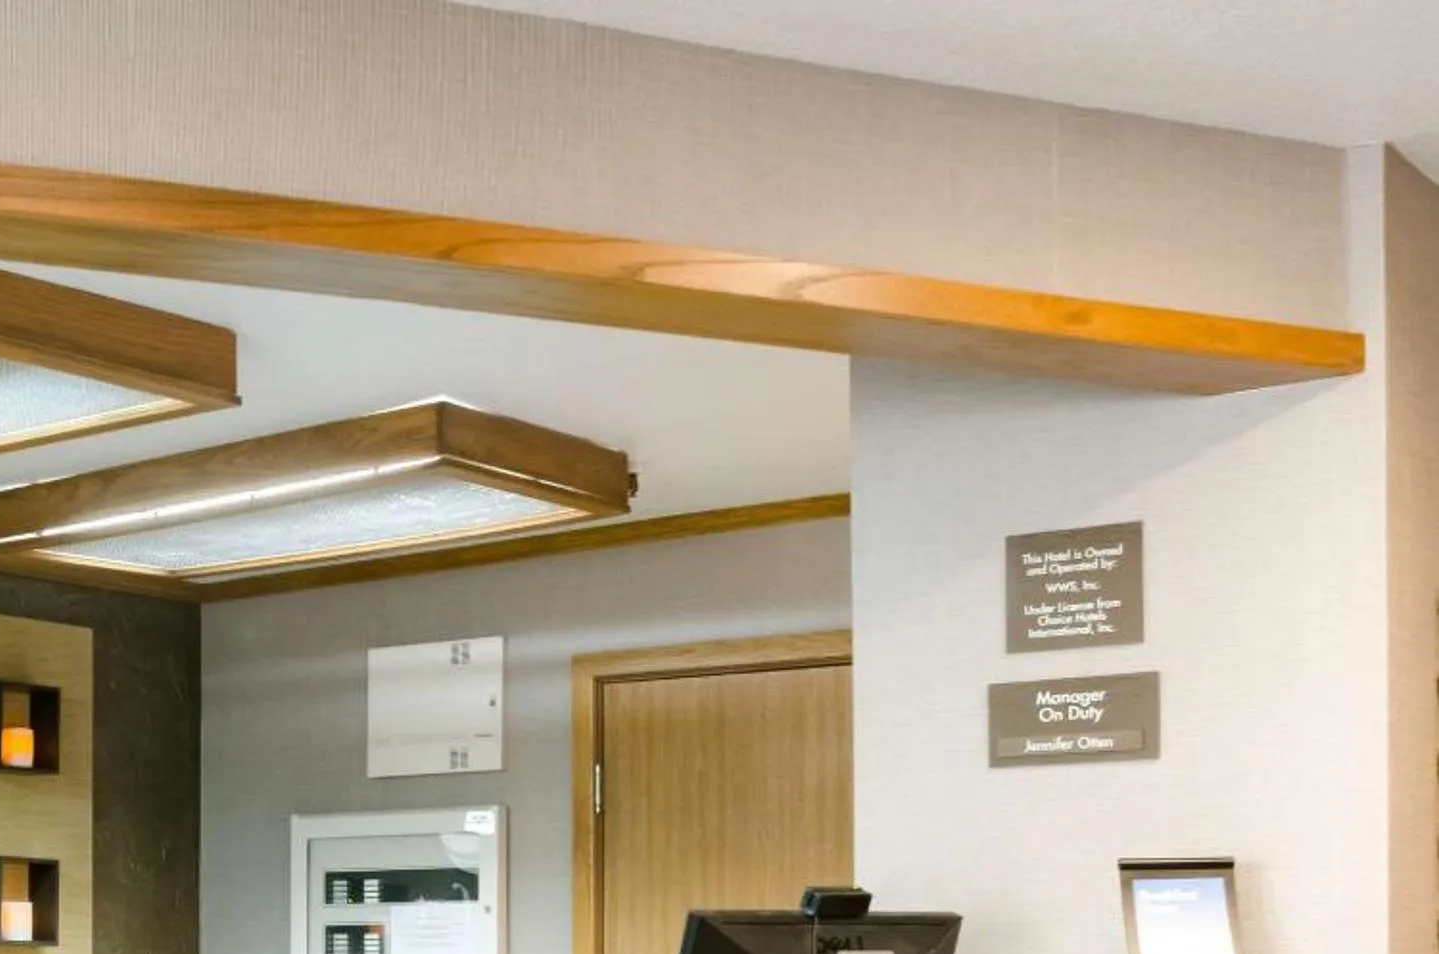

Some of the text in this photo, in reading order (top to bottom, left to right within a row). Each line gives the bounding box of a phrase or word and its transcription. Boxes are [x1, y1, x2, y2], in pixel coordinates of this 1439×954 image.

[1022, 543, 1123, 564] This Hotel is Owned
[1025, 563, 1047, 576] and
[1049, 558, 1098, 574] Operated
[1024, 596, 1121, 615] Under License from
[1037, 609, 1107, 626] Choice Hotels
[1035, 690, 1106, 707] Manager
[1039, 705, 1104, 723] On Duty
[1023, 736, 1076, 753] Jennifer
